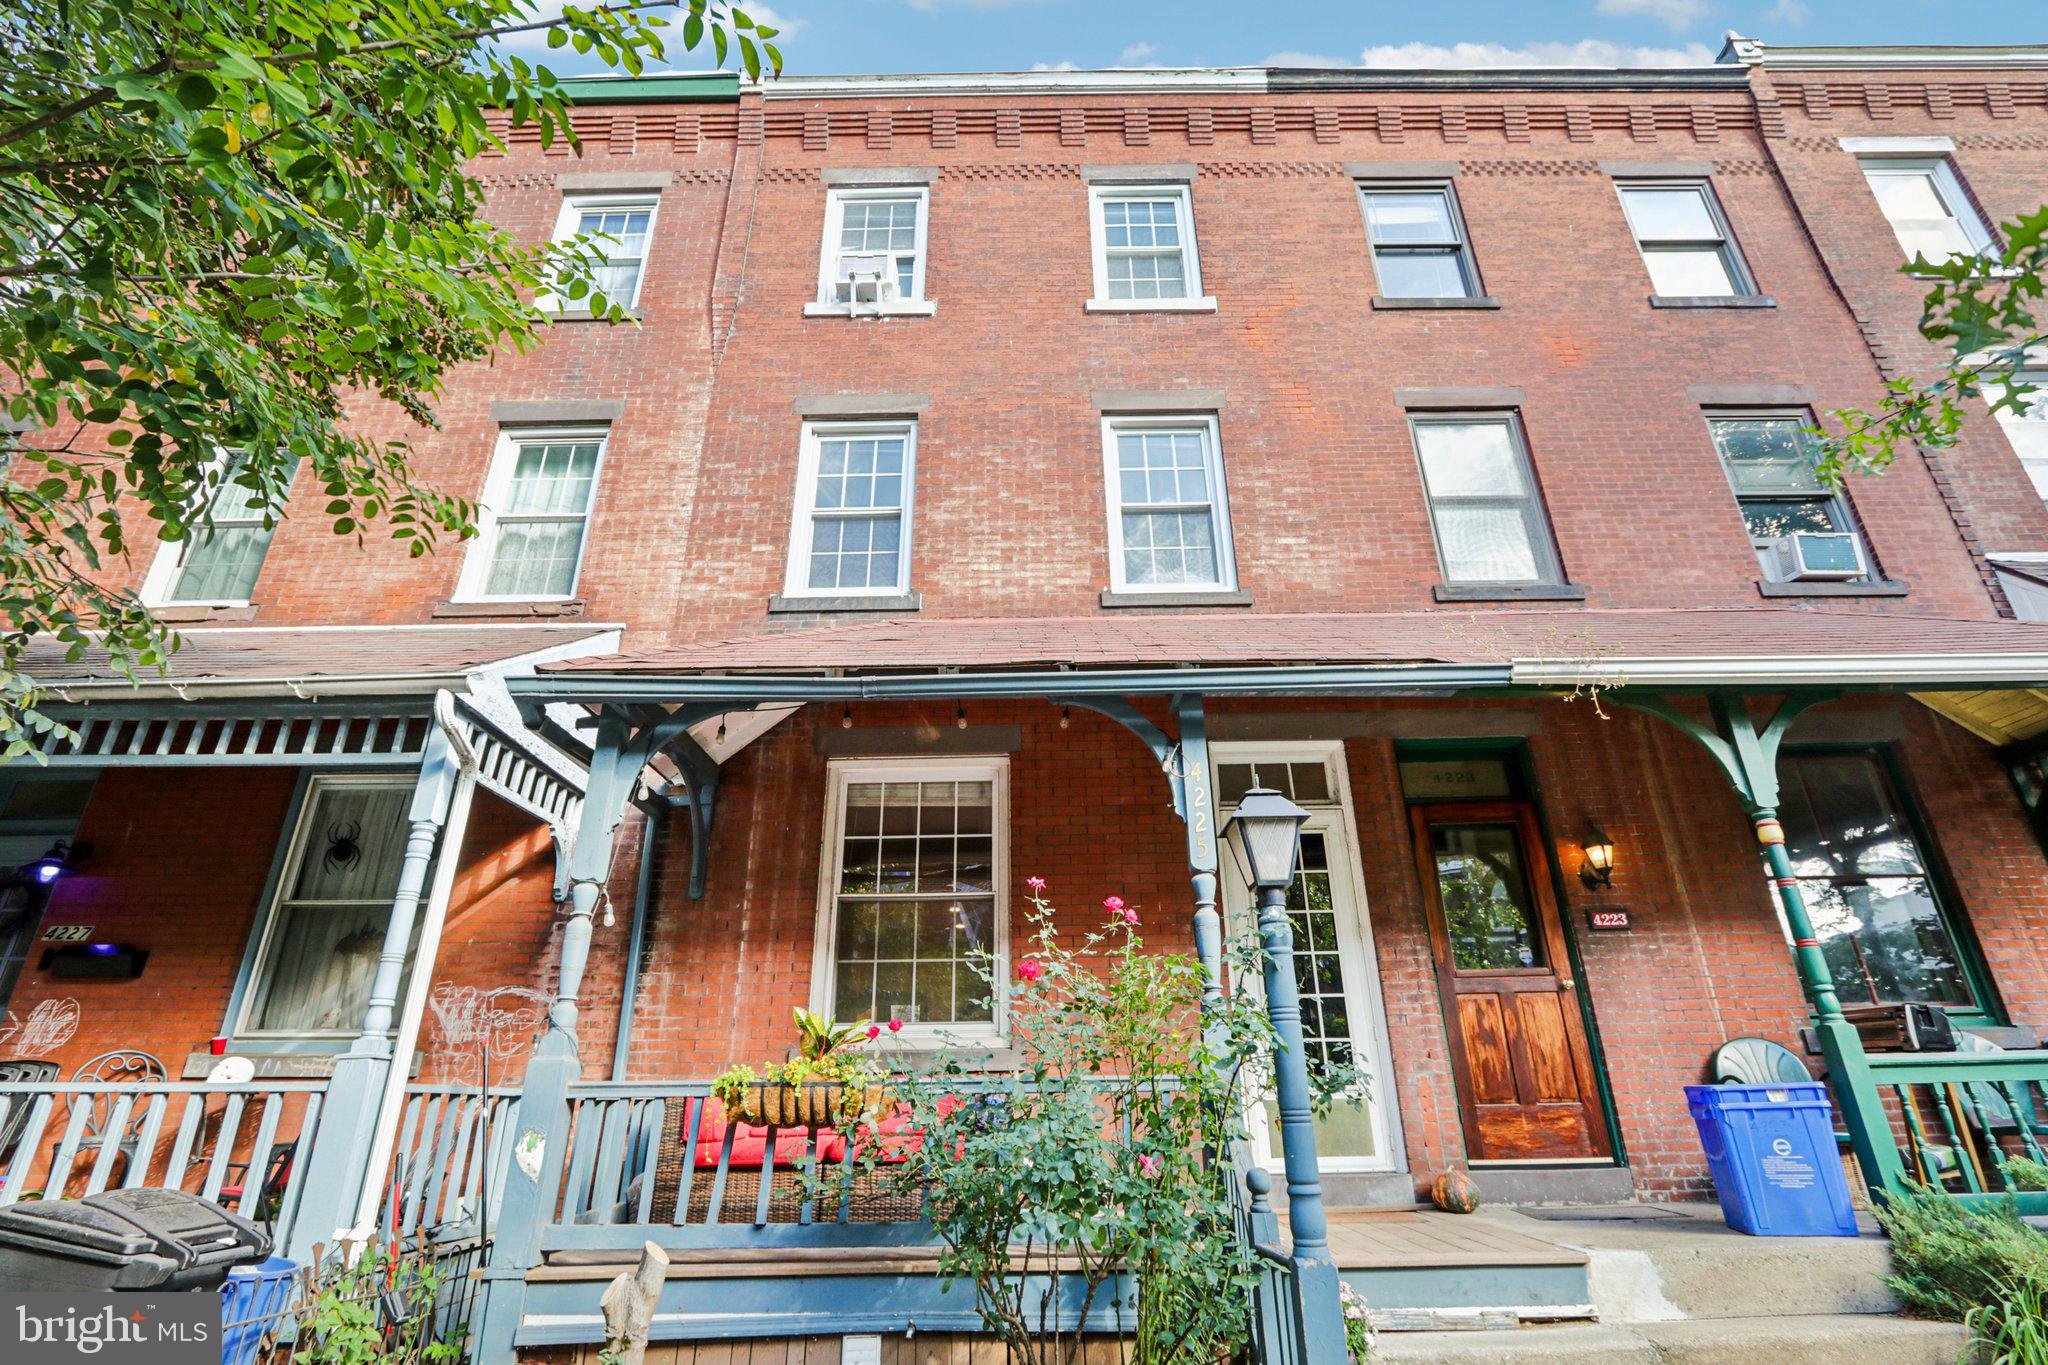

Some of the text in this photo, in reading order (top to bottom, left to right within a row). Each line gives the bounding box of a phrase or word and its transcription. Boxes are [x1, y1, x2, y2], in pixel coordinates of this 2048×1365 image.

[1190, 762, 1209, 860] 4225
[1593, 912, 1628, 926] 4223
[44, 926, 93, 940] 4227
